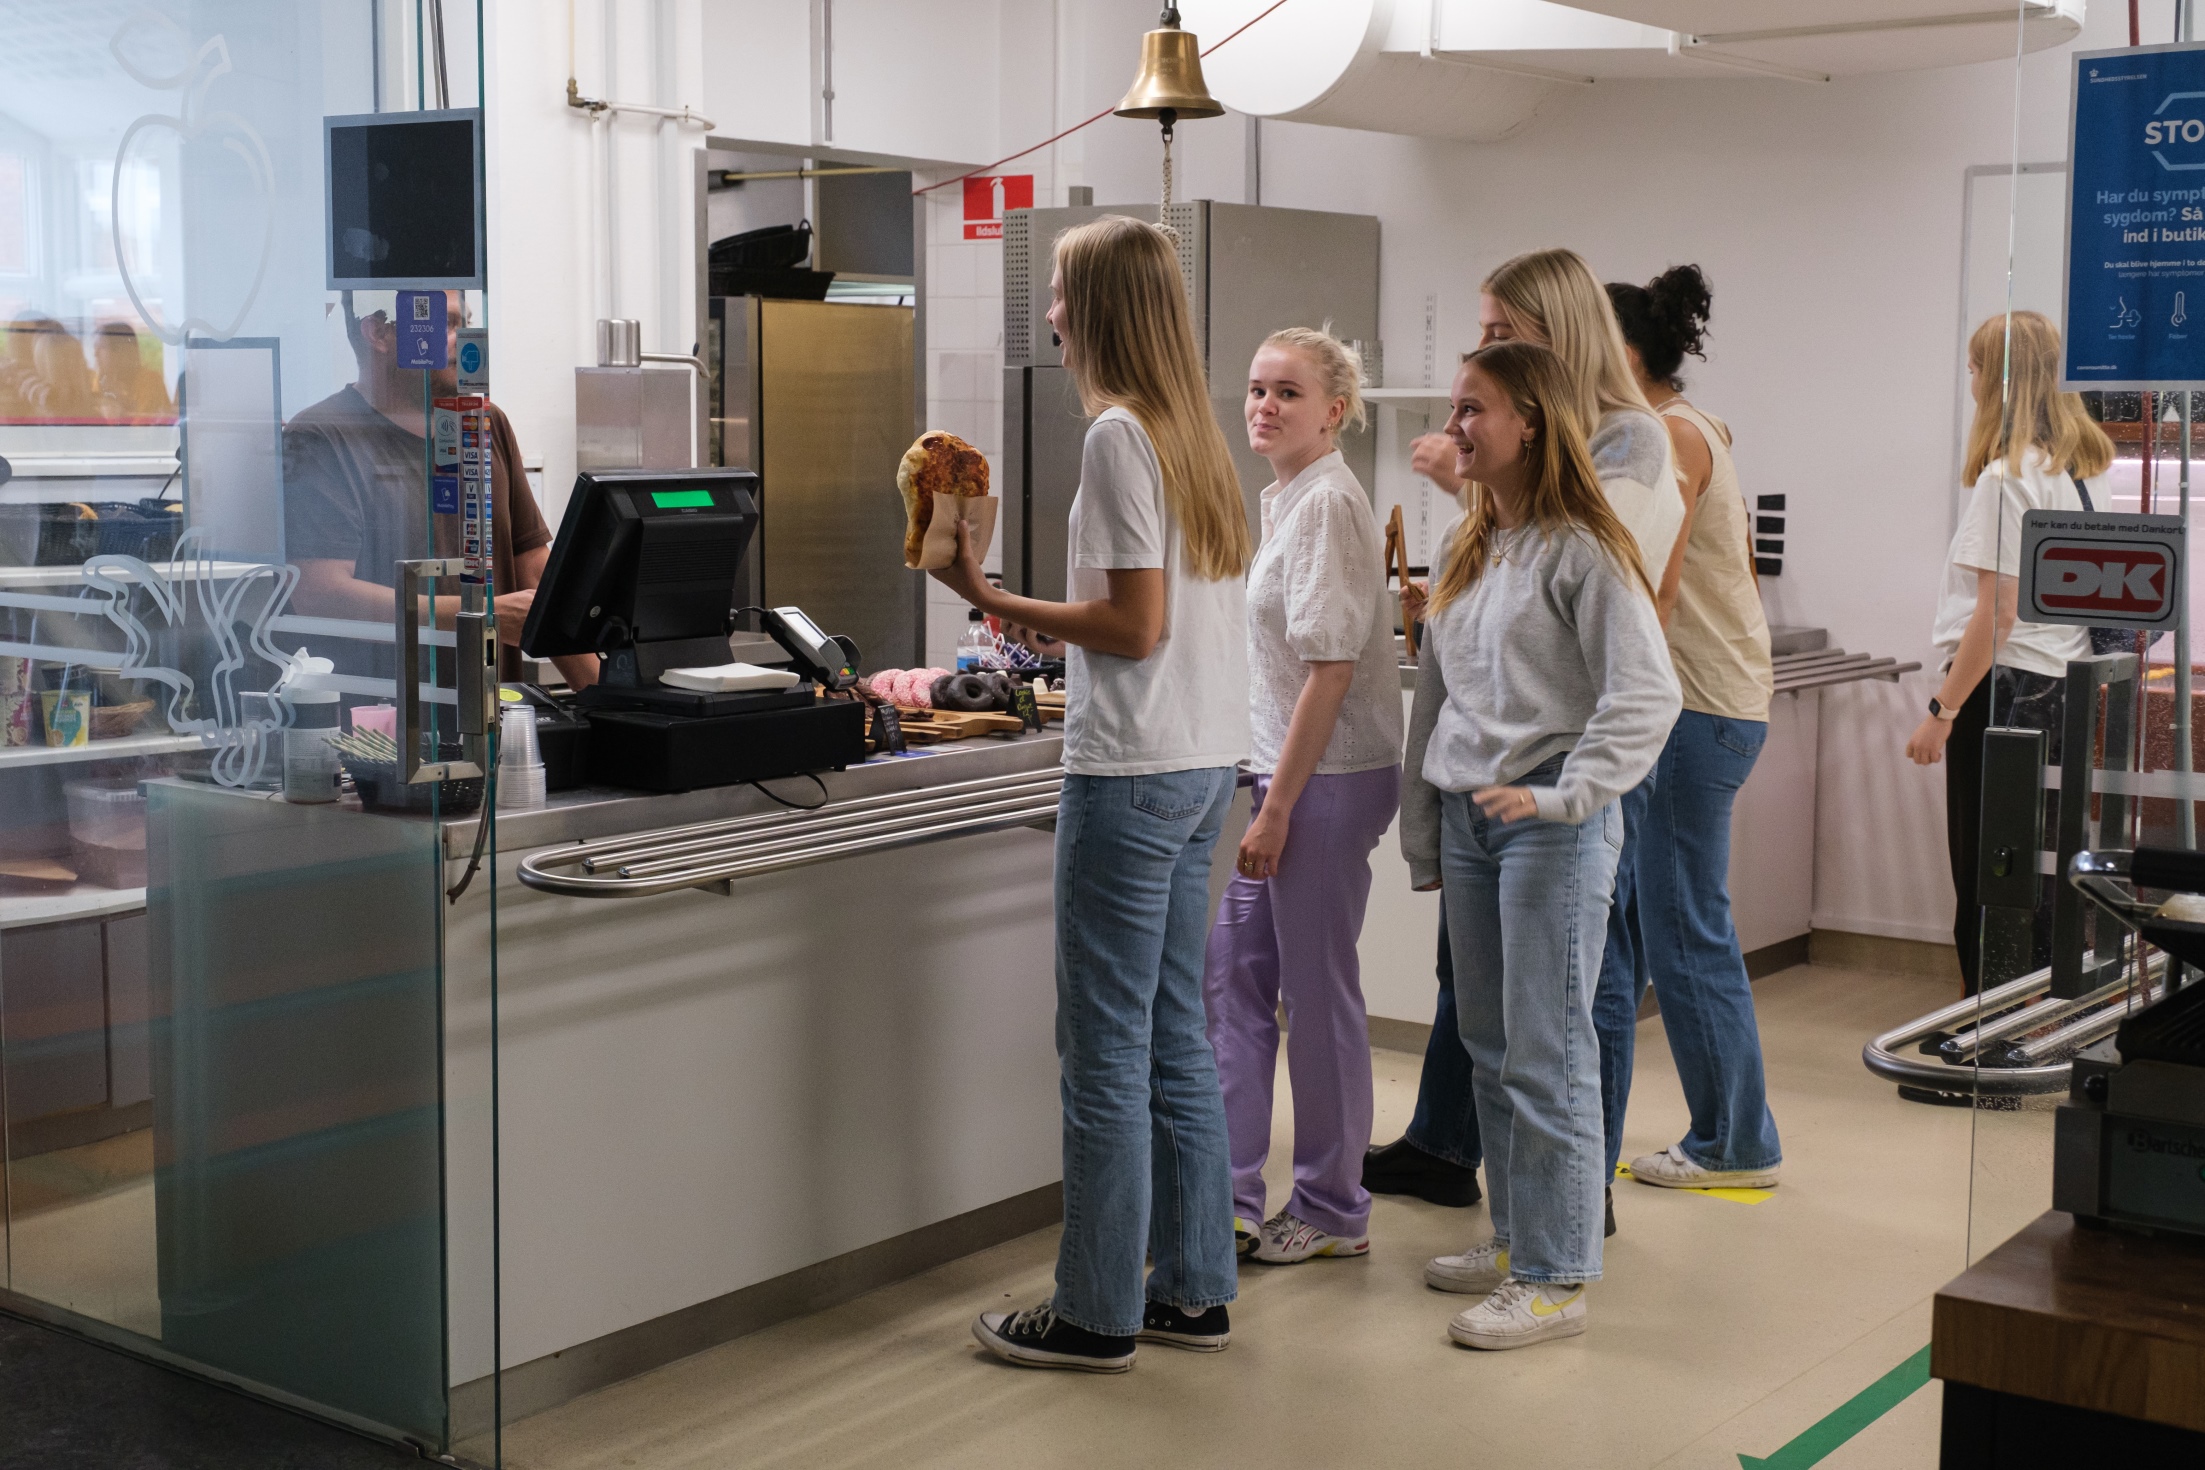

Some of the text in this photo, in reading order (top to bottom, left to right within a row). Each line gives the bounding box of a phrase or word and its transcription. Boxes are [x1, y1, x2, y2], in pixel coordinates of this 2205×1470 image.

[2089, 74, 2148, 83] SUNDHEDSSTYRELSEN
[2096, 190, 2125, 204] Har
[2127, 188, 2149, 203] du
[2103, 206, 2203, 228] sygdom? Så
[2123, 228, 2149, 243] ind
[2153, 227, 2159, 242] i
[2104, 261, 2114, 269] Du
[2130, 260, 2148, 268] blive
[2149, 260, 2181, 268] hjemme
[410, 324, 434, 333] 232306
[464, 451, 479, 460] VISA
[464, 468, 479, 477] VISA
[2031, 520, 2184, 535] Her kan du betale med Dankort
